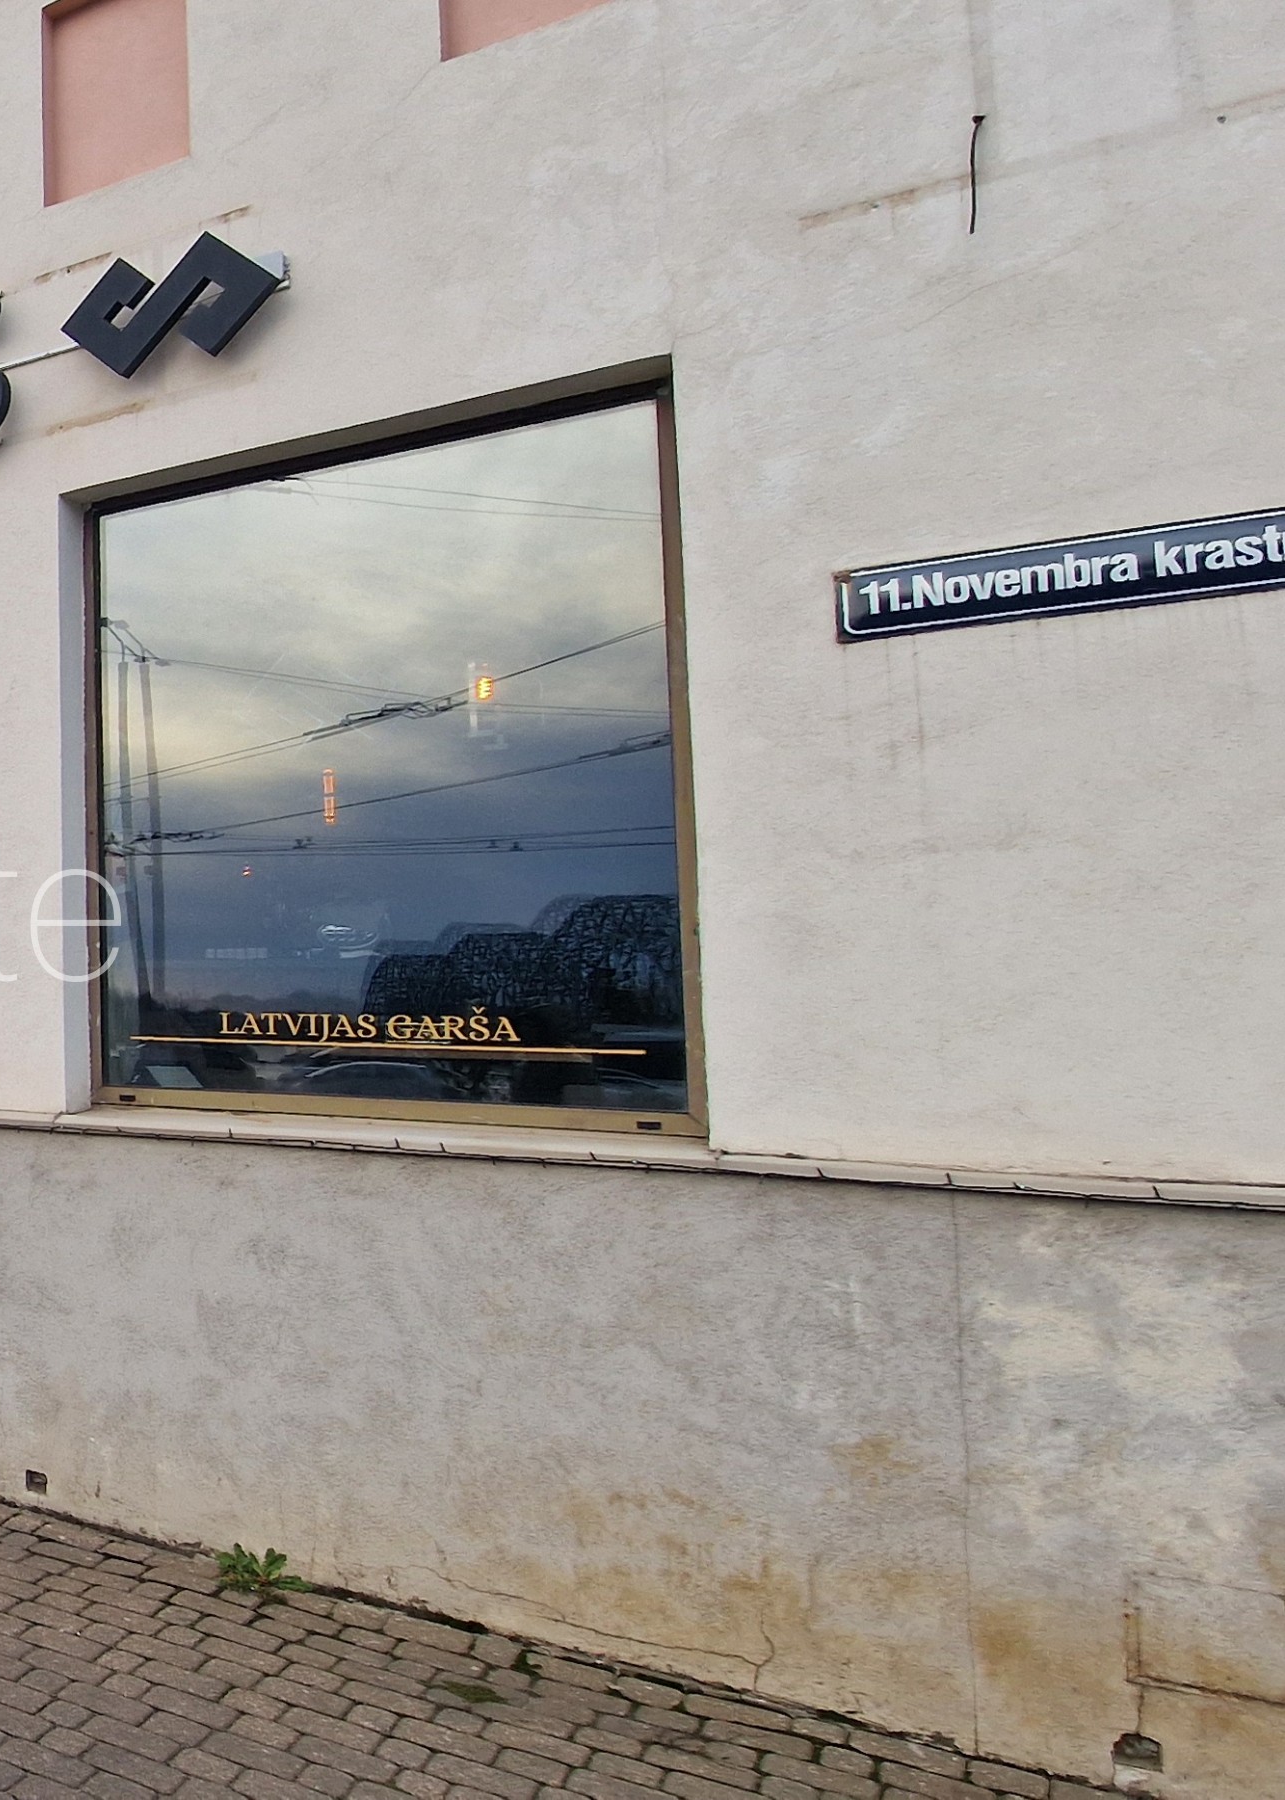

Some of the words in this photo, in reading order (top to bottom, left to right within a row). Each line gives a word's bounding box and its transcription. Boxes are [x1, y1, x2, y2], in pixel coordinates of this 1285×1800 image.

[858, 551, 1141, 615] 11.Novembra
[1153, 523, 1285, 579] krast
[219, 1011, 378, 1042] LATVIJAS
[387, 1006, 521, 1042] GARŠA
